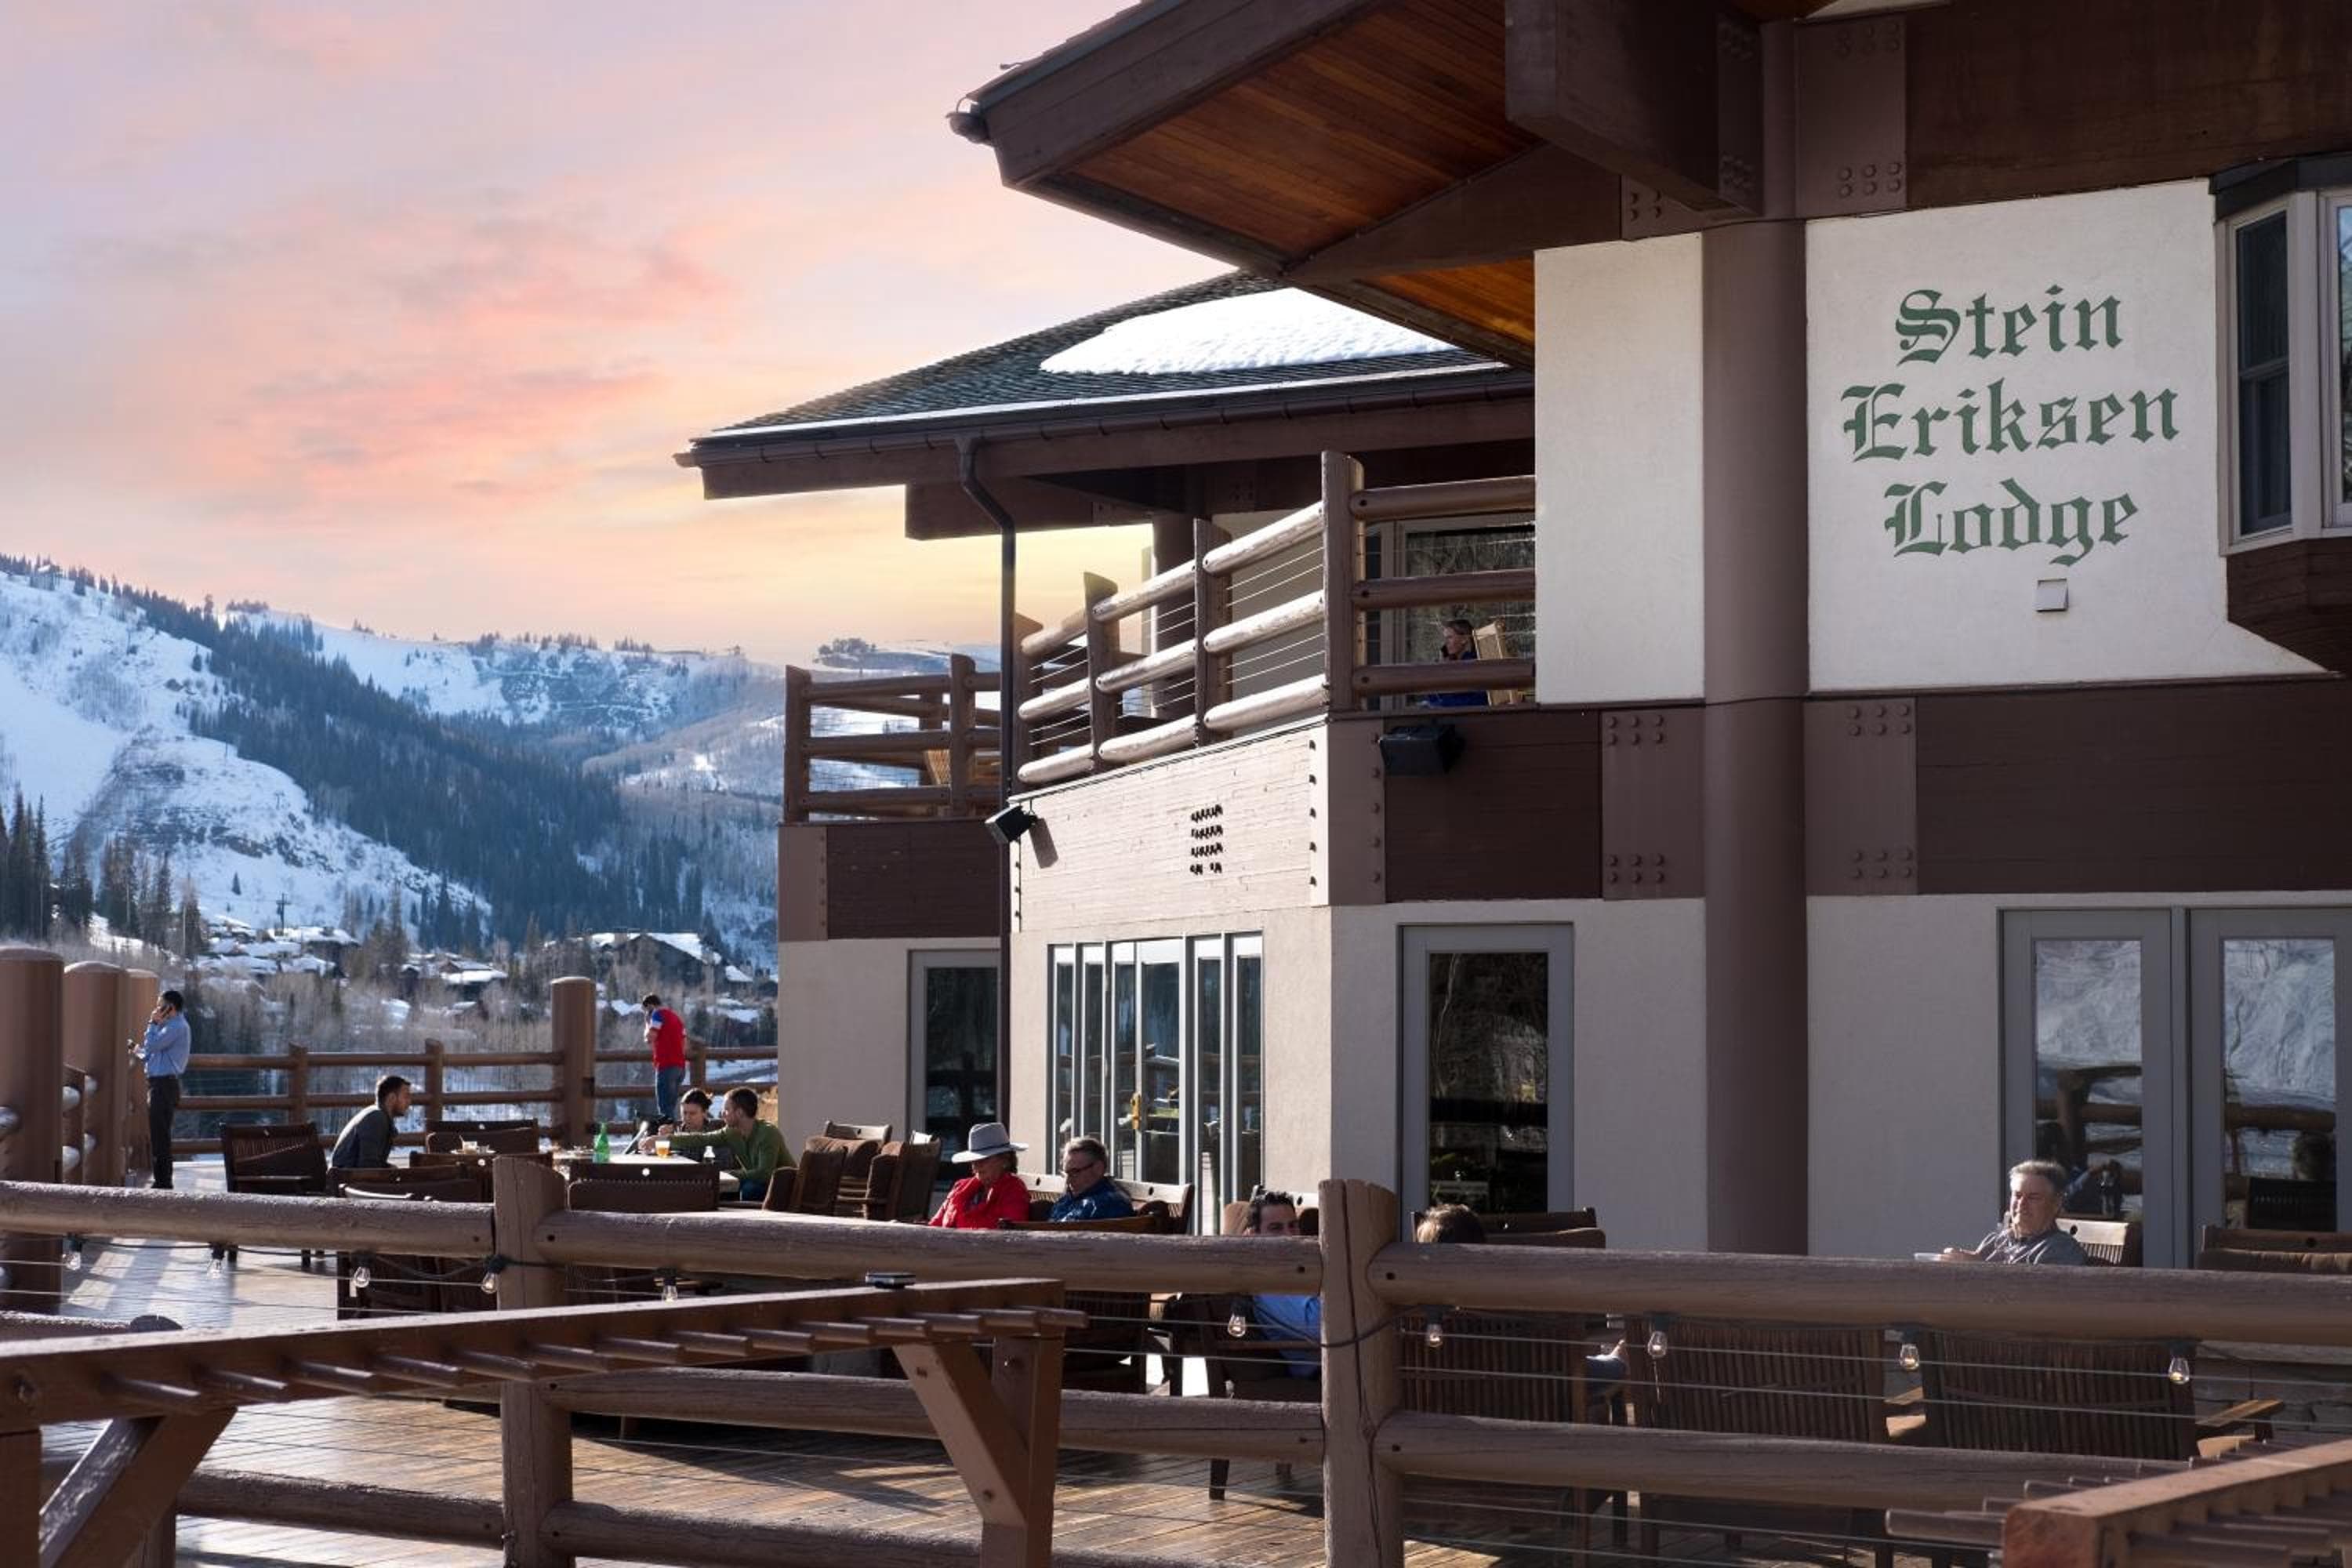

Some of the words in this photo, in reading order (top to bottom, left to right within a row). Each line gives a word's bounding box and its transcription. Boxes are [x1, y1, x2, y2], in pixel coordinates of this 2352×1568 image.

[1894, 284, 2124, 367] Stein
[1840, 377, 2180, 463] Eriksen
[1883, 477, 2140, 568] Lodge
